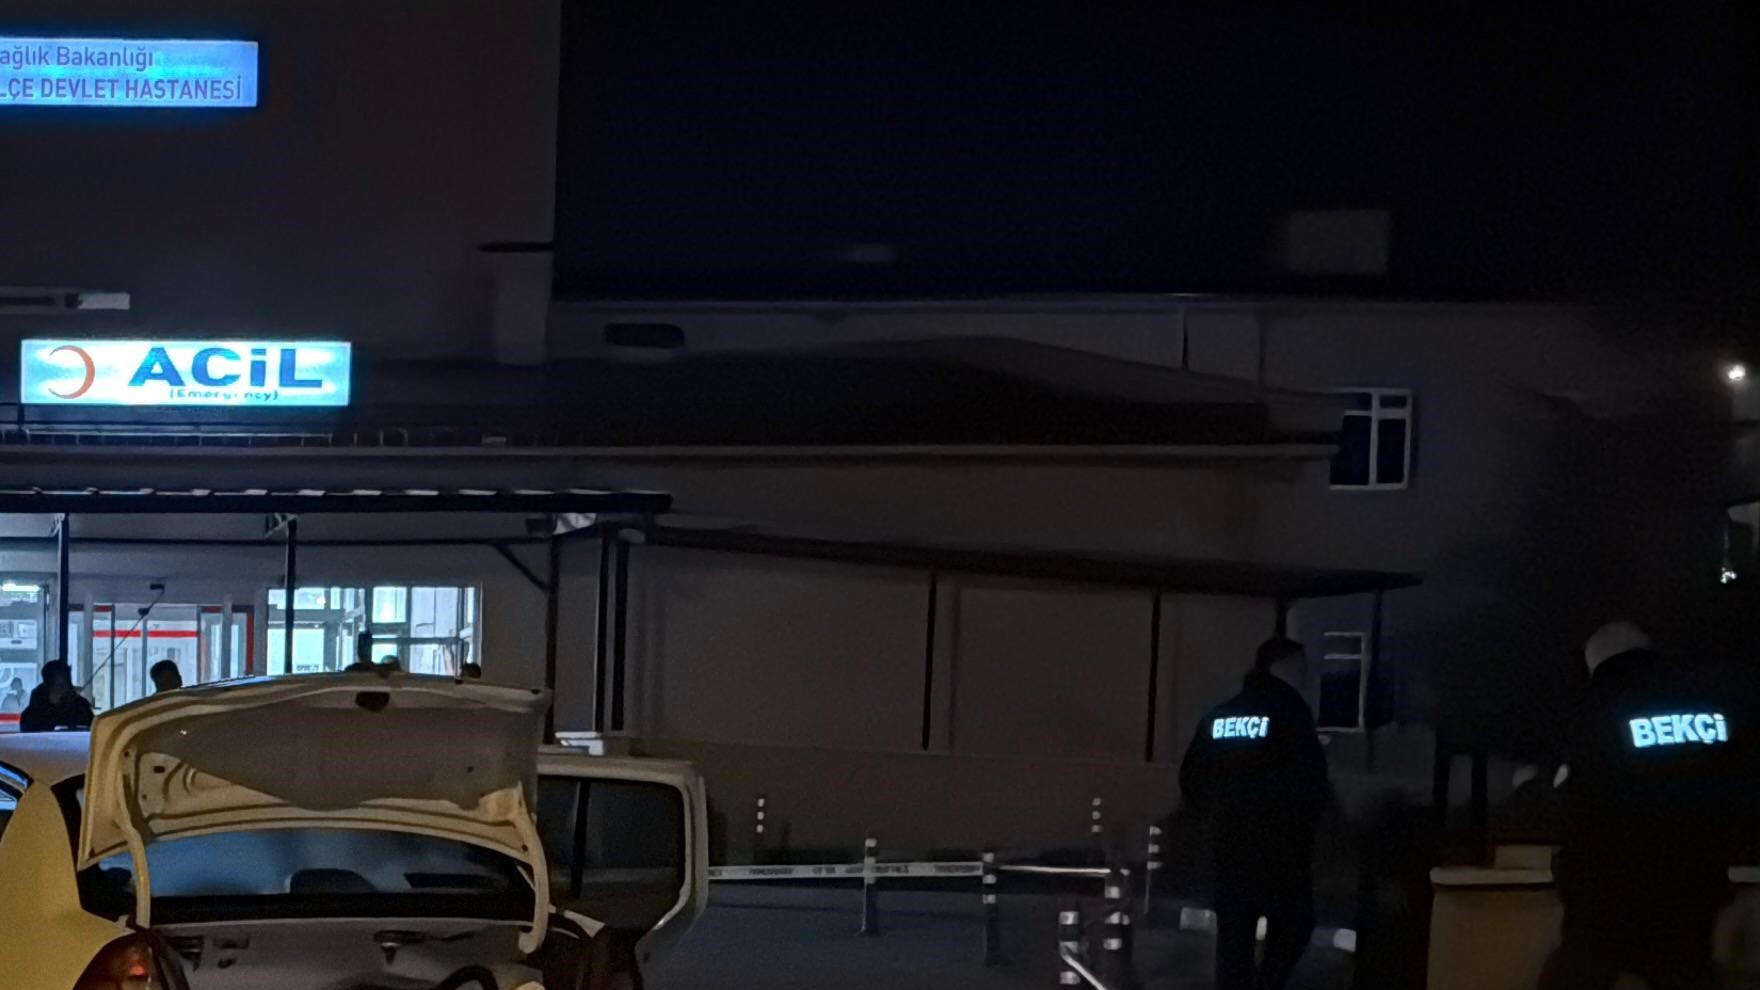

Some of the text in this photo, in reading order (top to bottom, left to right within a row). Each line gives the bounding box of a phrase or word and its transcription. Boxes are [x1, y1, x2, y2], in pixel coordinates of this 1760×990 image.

[56, 46, 154, 72] Bakanlığı
[41, 78, 119, 99] DEVLET
[126, 76, 241, 100] HASTANESİ
